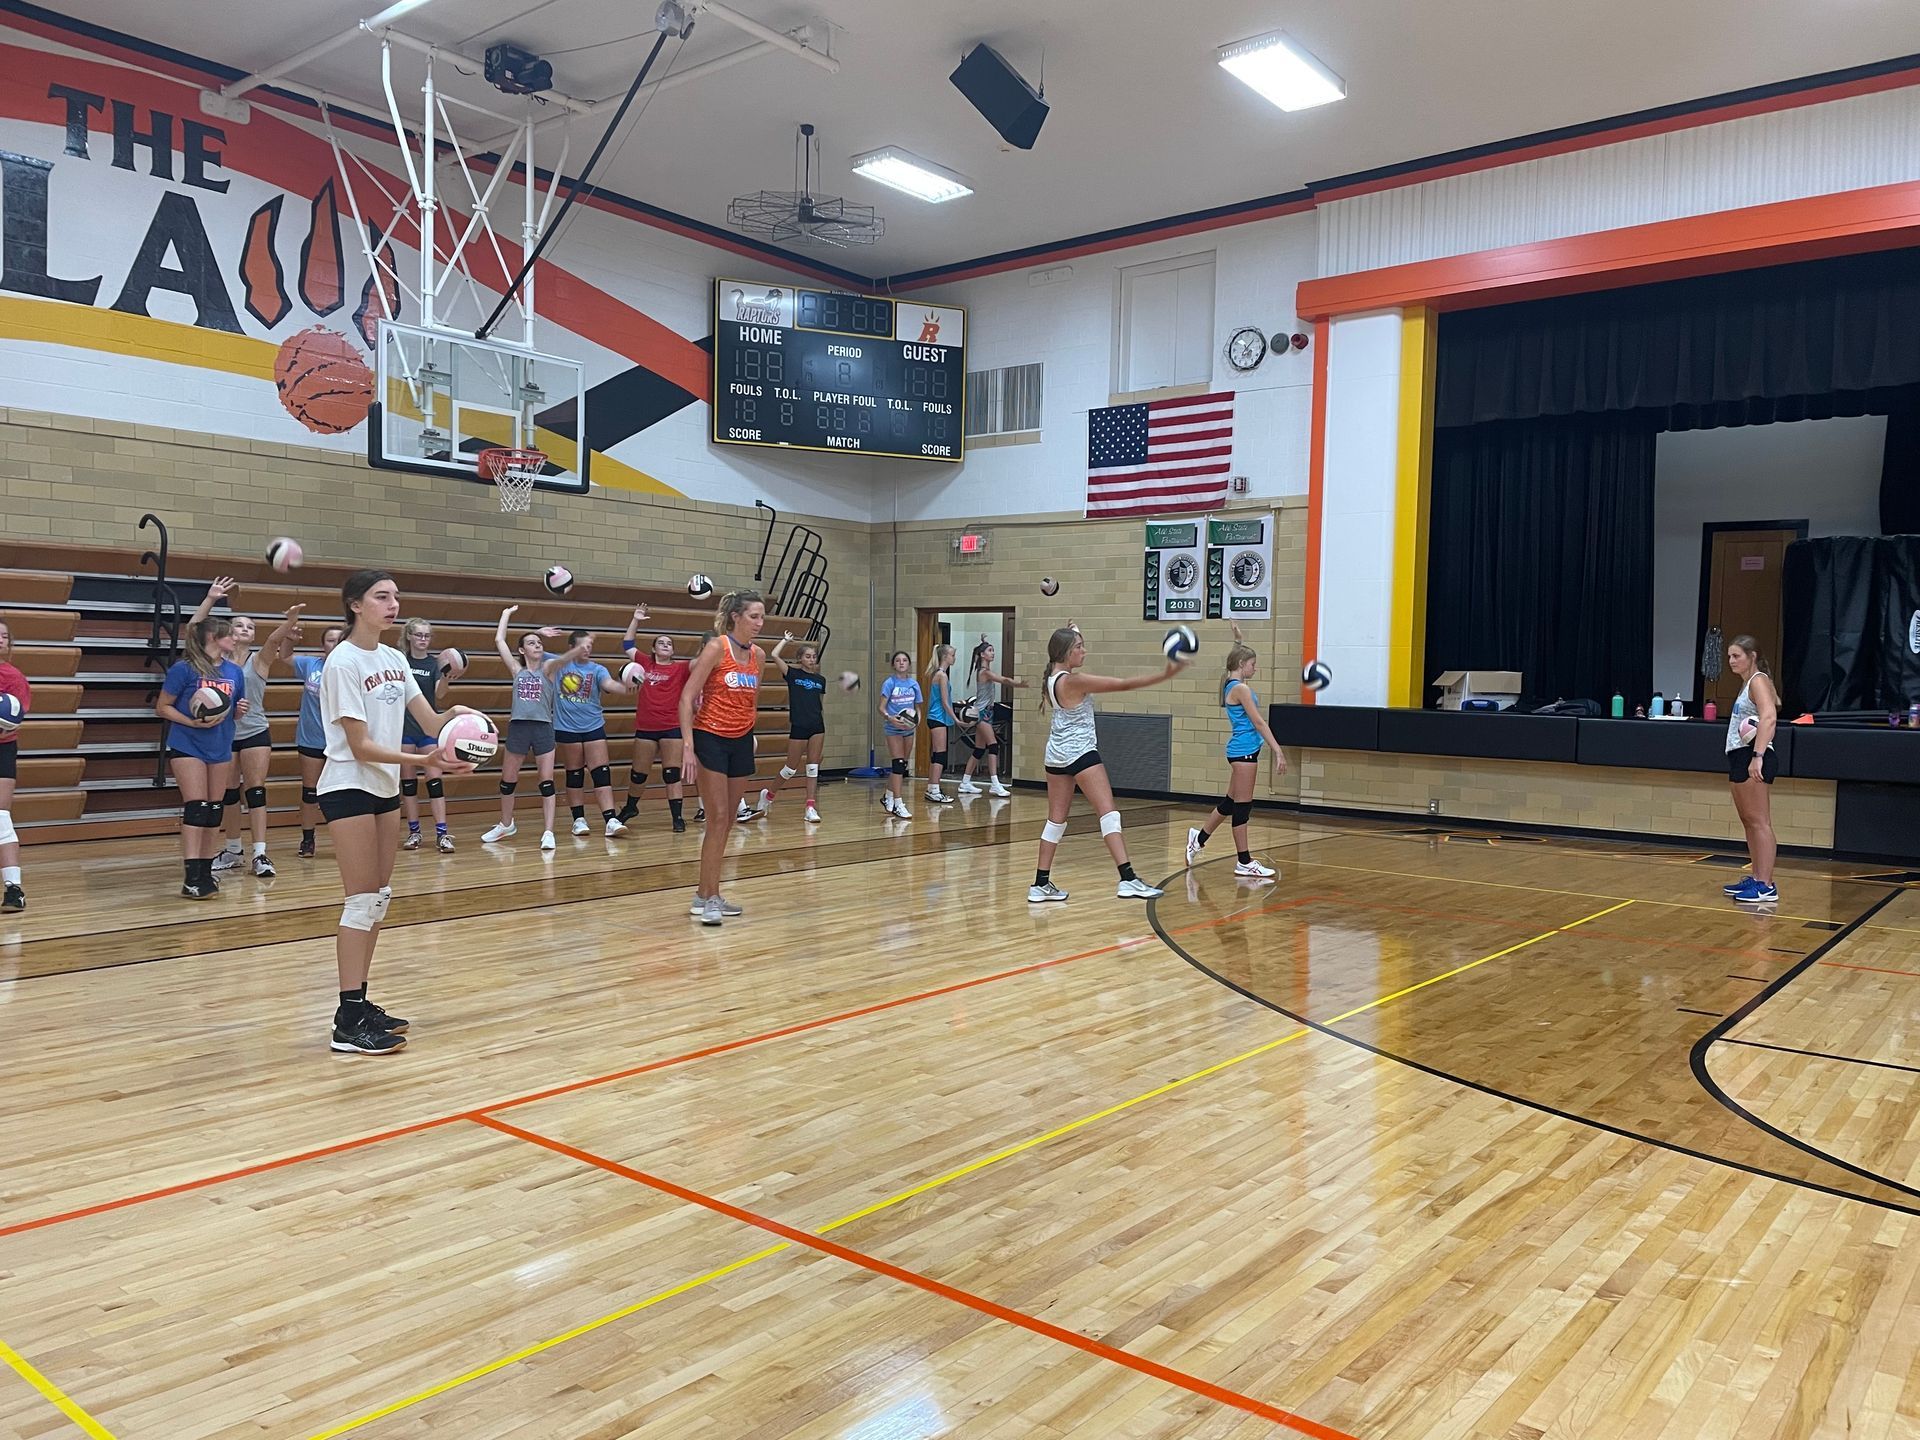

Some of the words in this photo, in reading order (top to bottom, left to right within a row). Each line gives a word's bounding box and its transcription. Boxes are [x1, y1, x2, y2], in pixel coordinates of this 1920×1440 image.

[47, 83, 231, 194] THE
[736, 306, 781, 325] RAPTORS
[739, 326, 782, 345] HOME
[828, 345, 862, 359] PERIOD
[903, 345, 947, 363] GUEST
[730, 384, 762, 396] FOULS
[774, 388, 801, 400] T.O.L.
[813, 391, 850, 404] PLAYER
[853, 396, 877, 408] FOUL
[887, 399, 913, 411] T.O.L.
[923, 402, 952, 414] FOULS
[729, 428, 761, 440] SCORE
[827, 436, 860, 449] MATCH
[922, 444, 951, 456] SCORE
[1170, 601, 1195, 609] 2019
